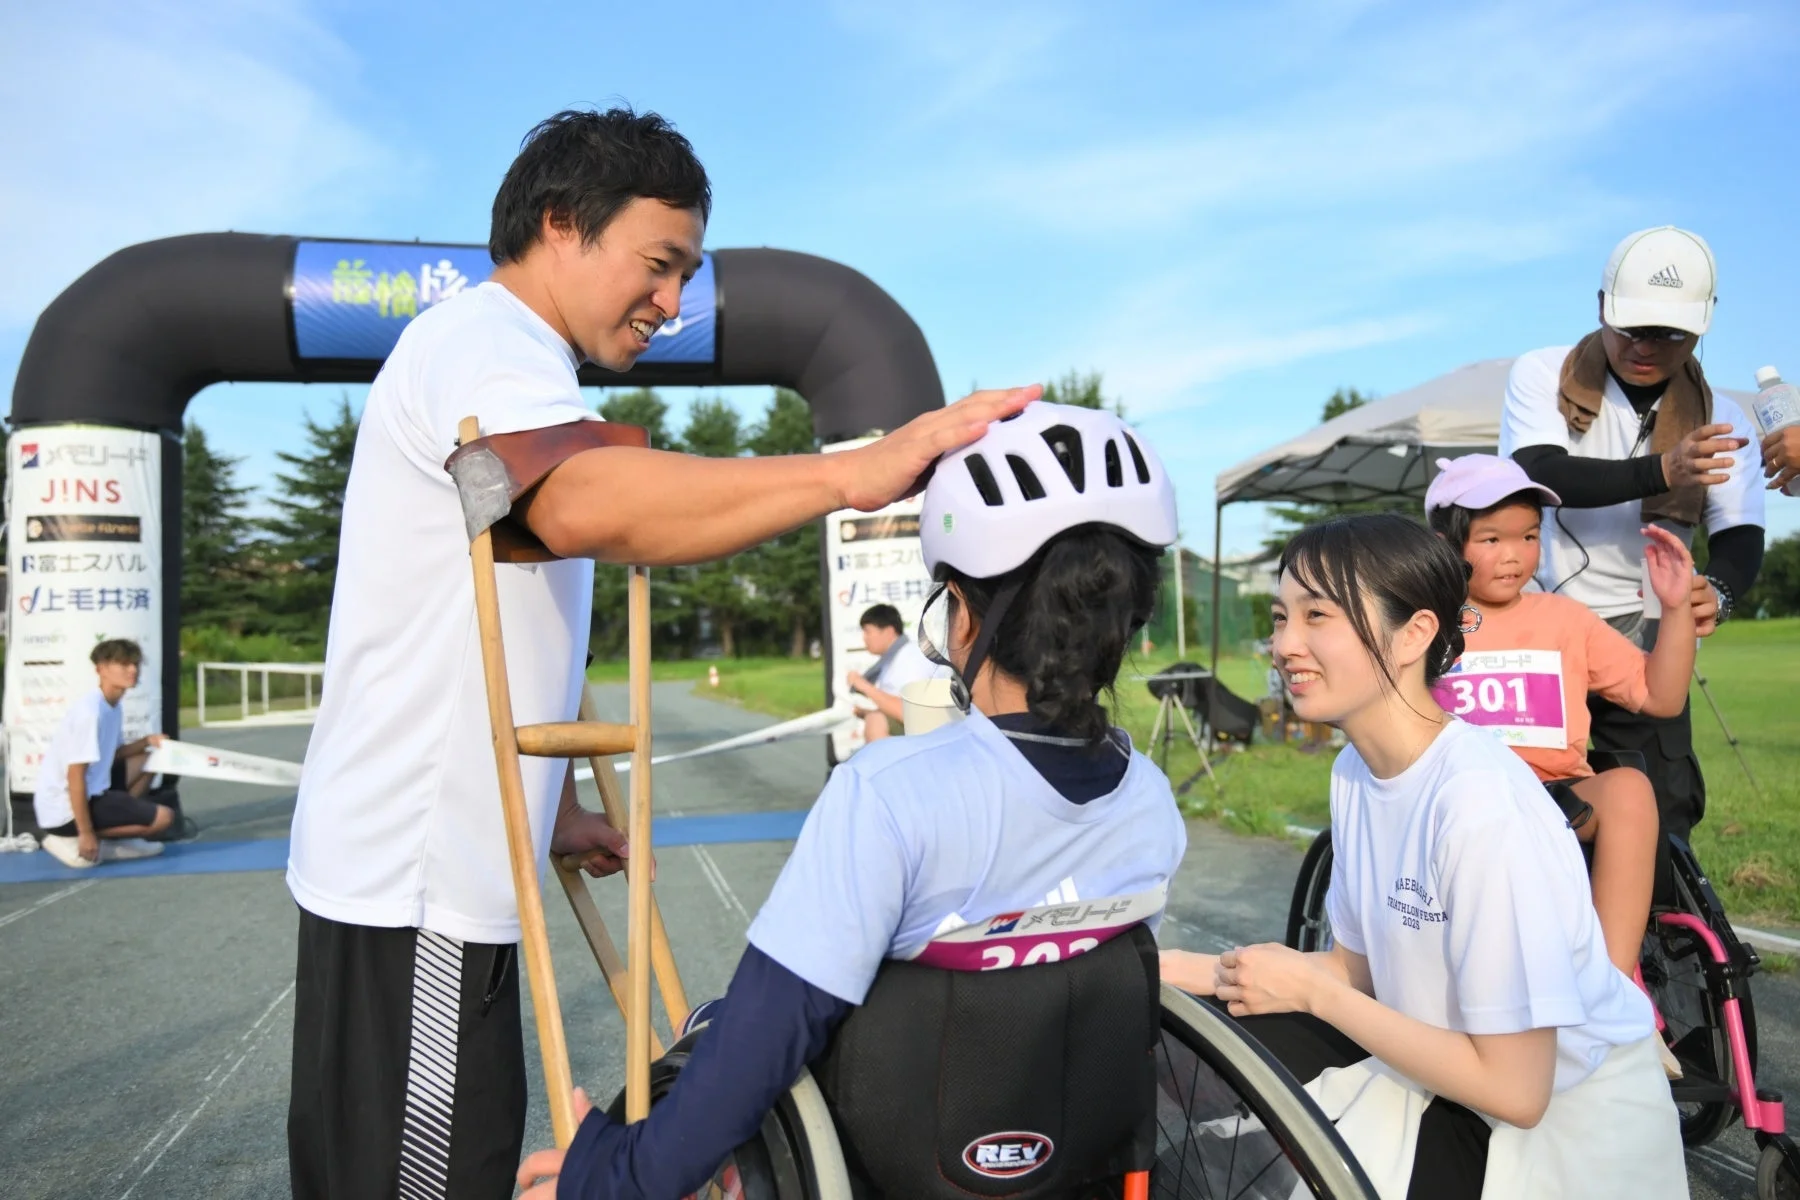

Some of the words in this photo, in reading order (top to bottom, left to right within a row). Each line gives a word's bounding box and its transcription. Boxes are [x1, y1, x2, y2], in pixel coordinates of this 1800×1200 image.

[1648, 278, 1683, 288] adidas
[45, 444, 149, 467] メモリード
[39, 553, 147, 573] 富士スバル
[41, 588, 150, 611] 上毛共済
[859, 580, 928, 604] 上毛共
[1452, 678, 1527, 715] 301
[1021, 900, 1132, 929] メモリード
[1387, 896, 1420, 918] TRIATHLON
[1420, 909, 1449, 922] FESTA
[1403, 915, 1420, 930] 2025
[976, 1142, 1043, 1163] REV
